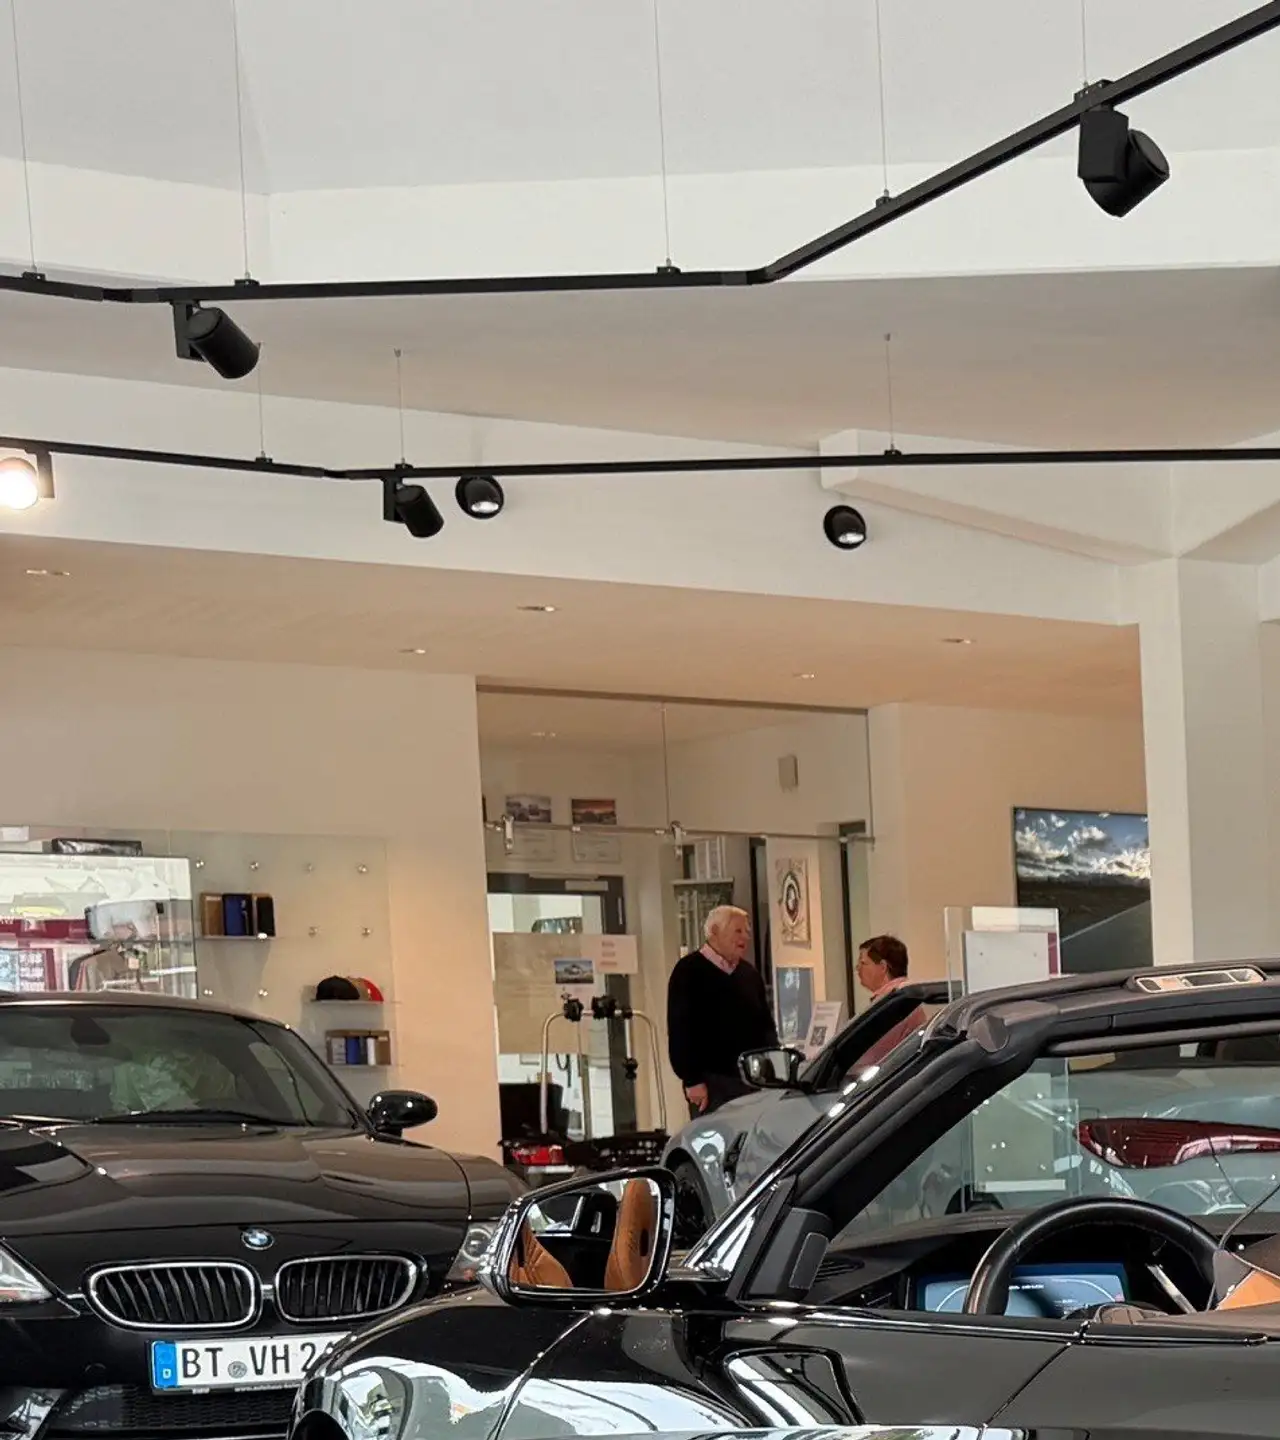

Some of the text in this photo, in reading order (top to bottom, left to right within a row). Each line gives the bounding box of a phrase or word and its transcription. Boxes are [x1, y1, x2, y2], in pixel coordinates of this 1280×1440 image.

[182, 1347, 223, 1379] BT
[249, 1343, 290, 1376] VH
[300, 1341, 333, 1373] 2
